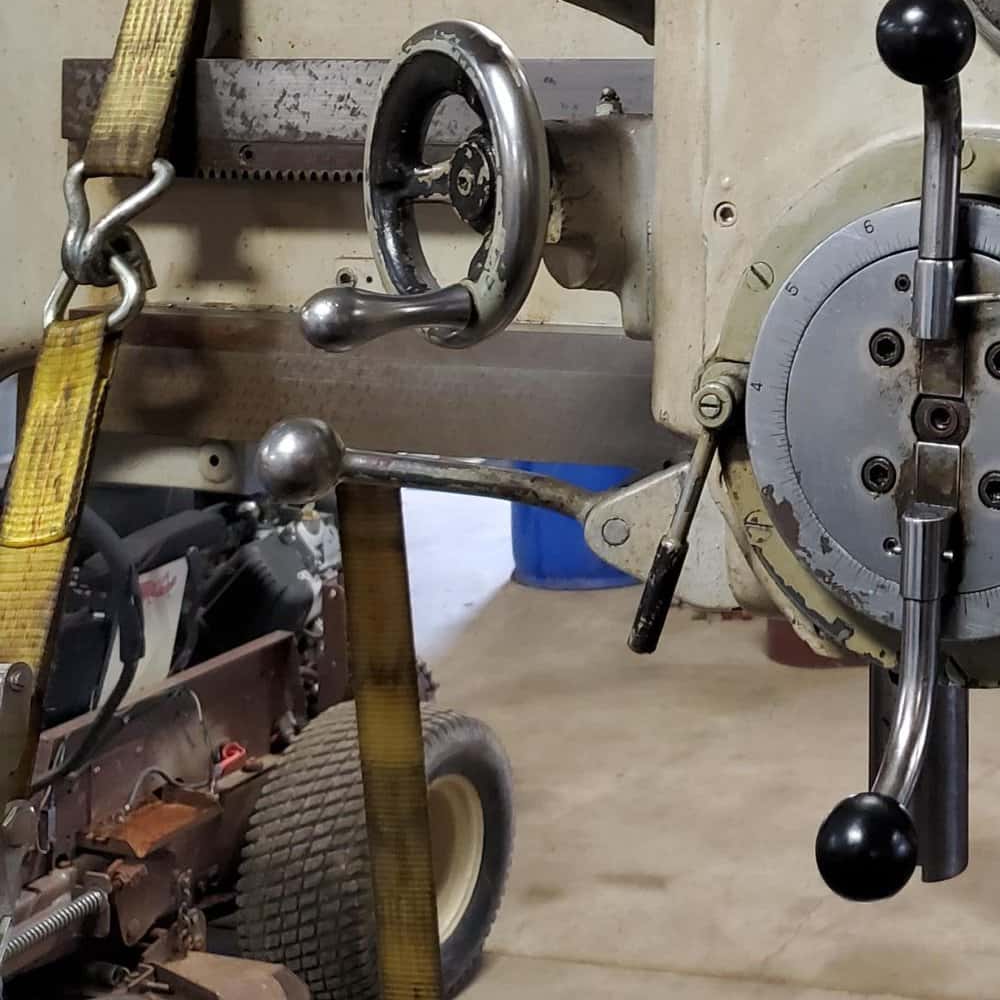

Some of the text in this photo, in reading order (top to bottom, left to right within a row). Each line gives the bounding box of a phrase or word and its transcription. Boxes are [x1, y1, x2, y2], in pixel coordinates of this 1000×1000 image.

[863, 219, 875, 234] 6
[785, 281, 799, 297] 5
[750, 381, 764, 392] 4
